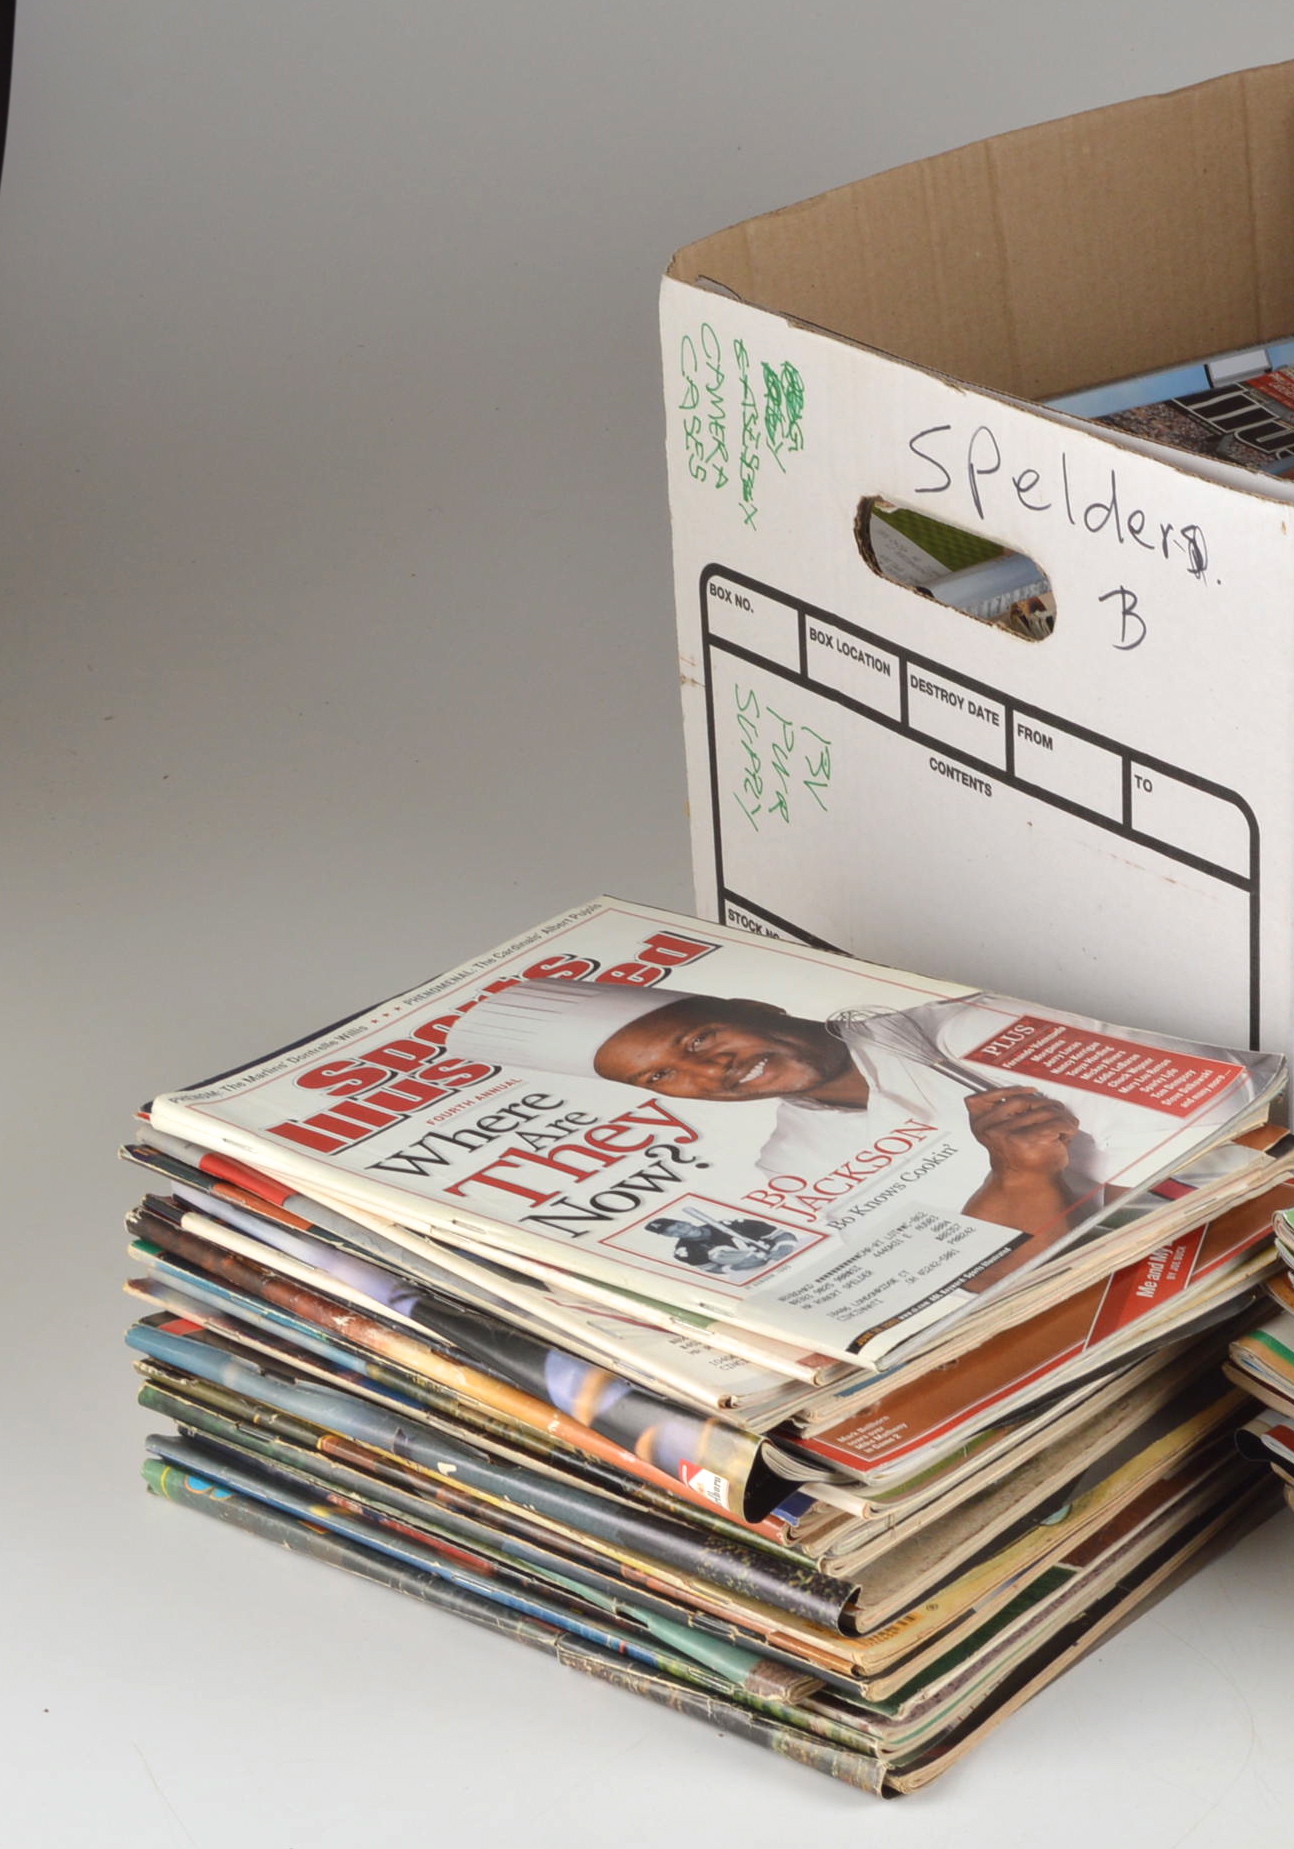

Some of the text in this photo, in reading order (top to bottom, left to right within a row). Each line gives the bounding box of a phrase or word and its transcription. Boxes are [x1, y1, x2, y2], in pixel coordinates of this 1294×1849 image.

[709, 582, 754, 613] BOX NO.
[1099, 585, 1148, 651] B
[809, 626, 891, 677] BOX LOCATION
[910, 674, 1000, 727] DESTROY DATE
[1017, 724, 1054, 751] FROM
[929, 756, 993, 798] CONTENTS
[1134, 774, 1153, 793] TO
[541, 915, 572, 937] Albert
[728, 908, 764, 935] STOCK
[981, 1023, 1036, 1057] PLUS
[427, 1076, 523, 1126] FOURTH ANNUAL
[367, 1092, 564, 1179] Where
[444, 1097, 701, 1208] They
[514, 1108, 601, 1154] Are
[520, 1143, 710, 1239] Now?
[742, 1170, 808, 1209] BO
[776, 1119, 939, 1223] JACKSON
[827, 1214, 855, 1232] Bo
[850, 1179, 906, 1218] Knows
[1136, 1281, 1158, 1298] Me
[1147, 1261, 1165, 1281] and
